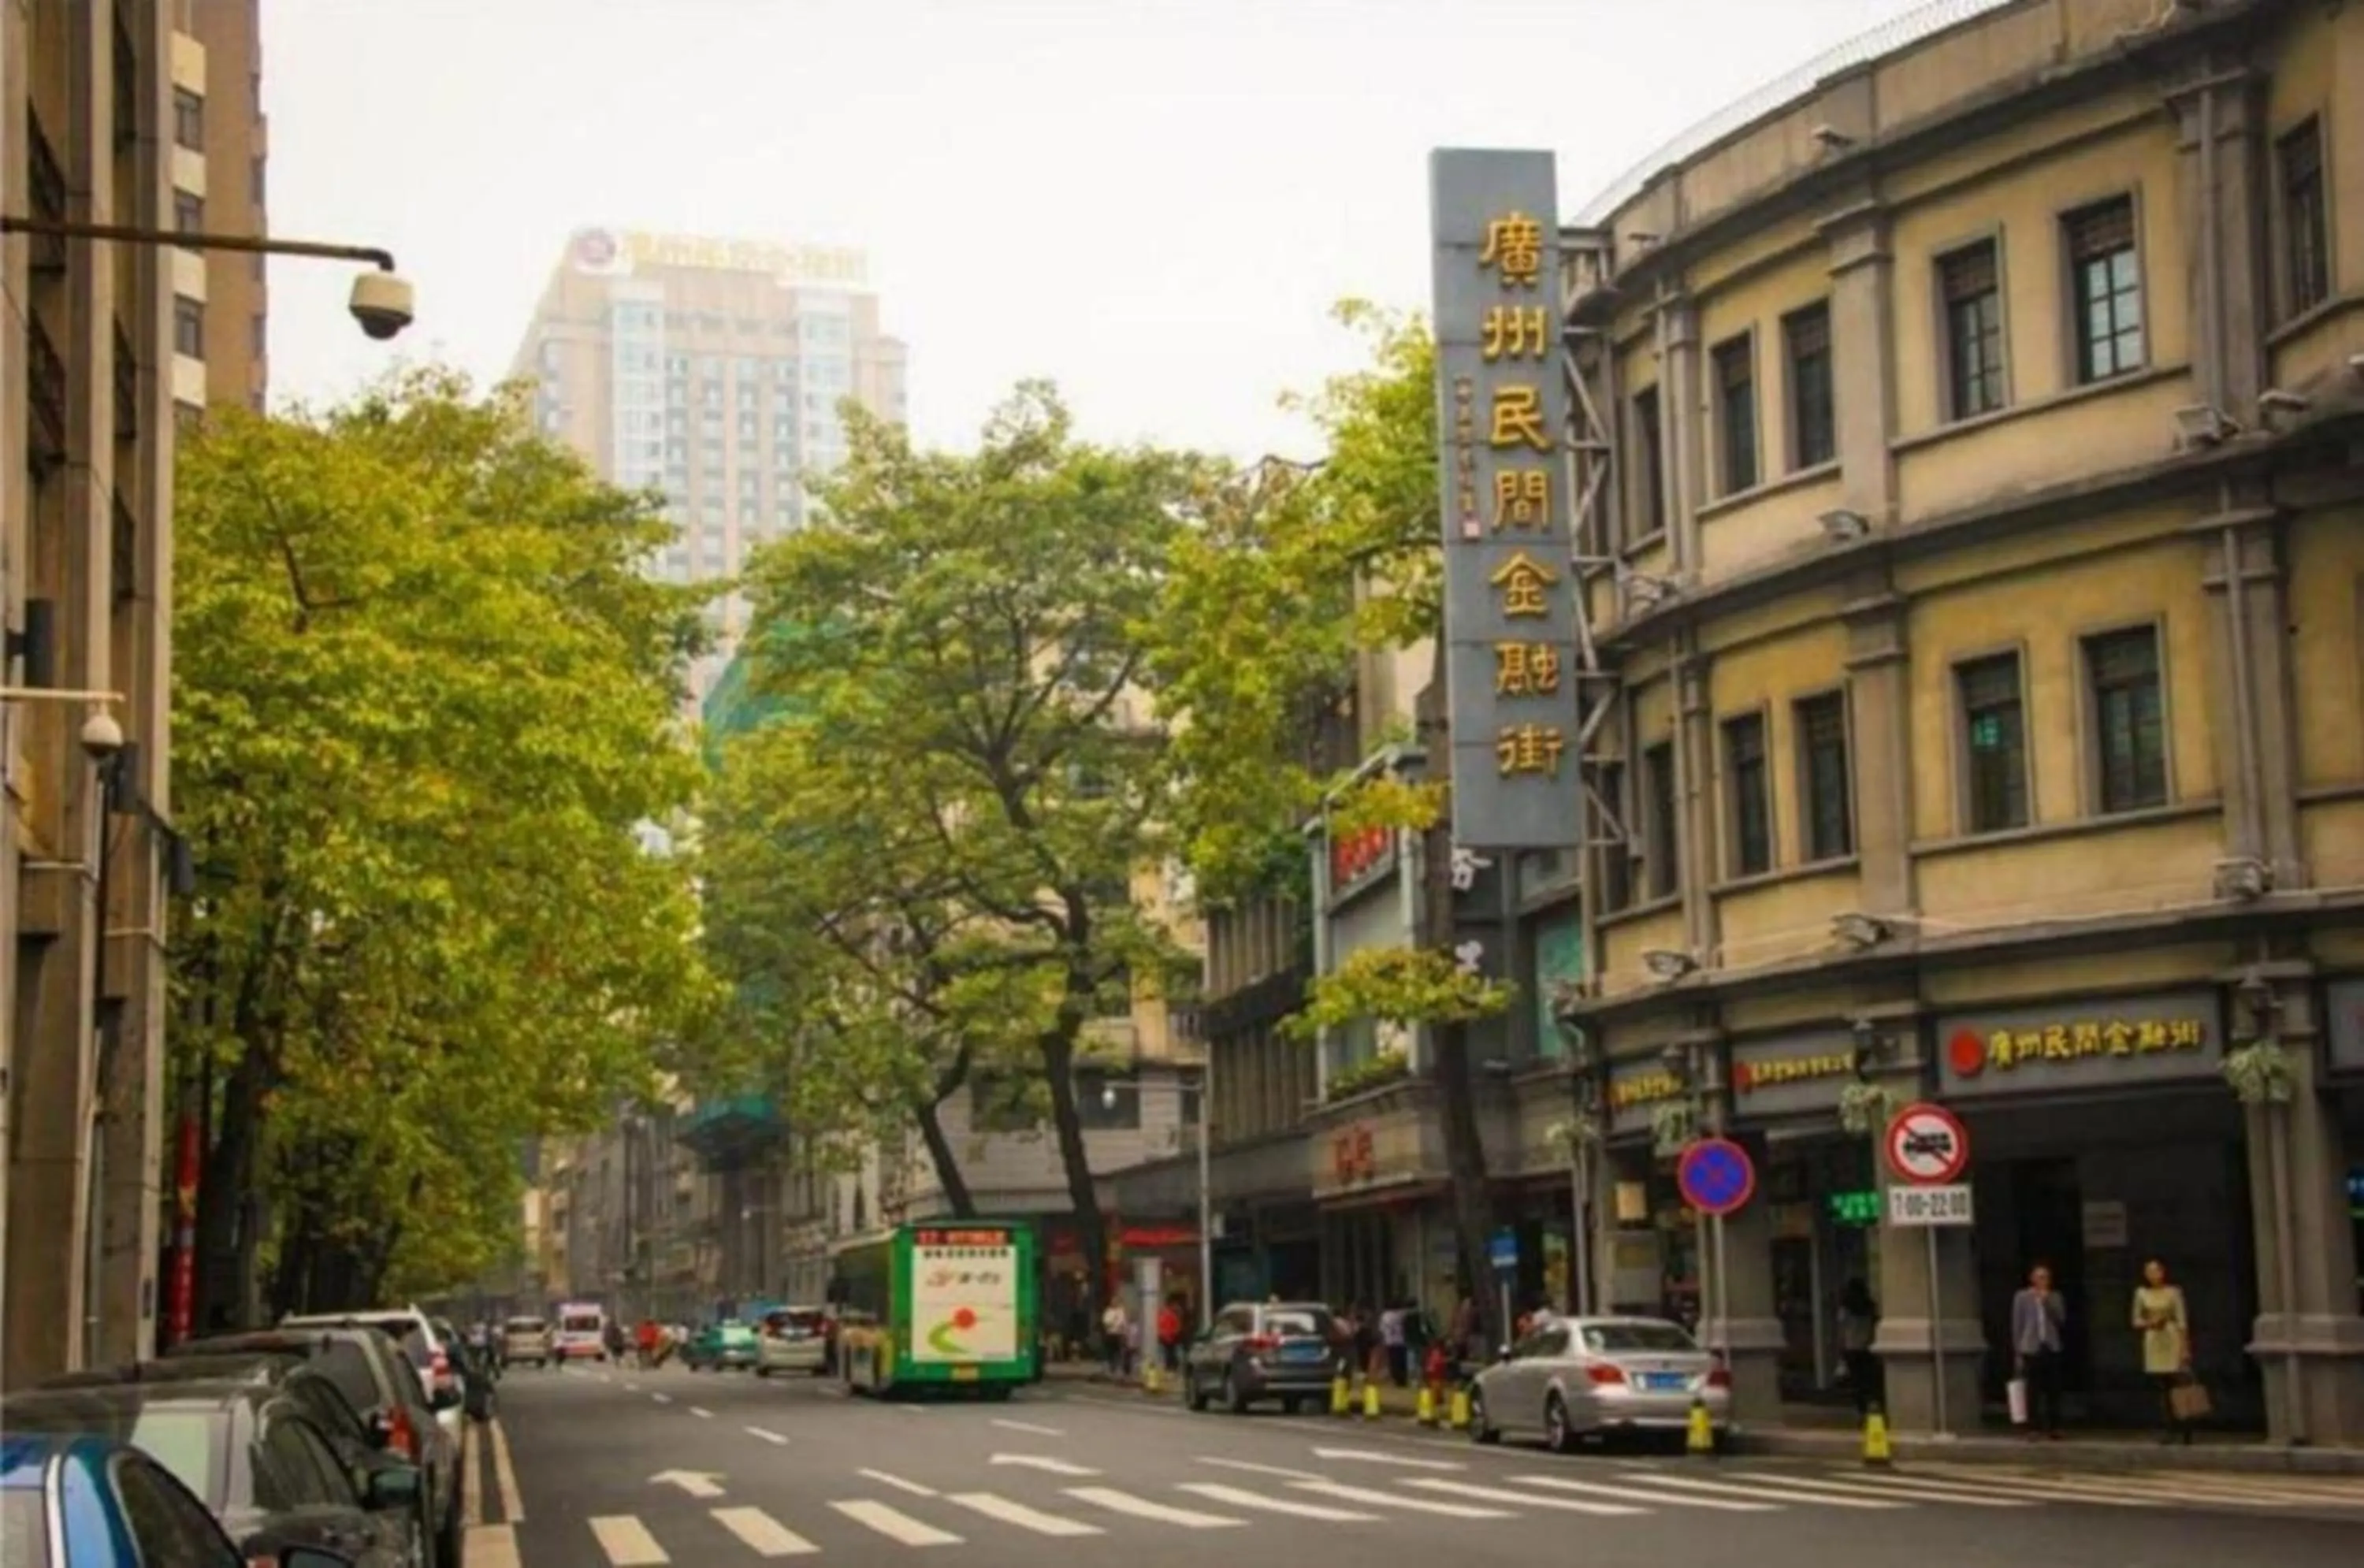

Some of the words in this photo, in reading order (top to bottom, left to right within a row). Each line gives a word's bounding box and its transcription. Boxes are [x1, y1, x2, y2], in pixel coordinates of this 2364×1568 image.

[1478, 210, 1566, 778] 廣州民間金融街
